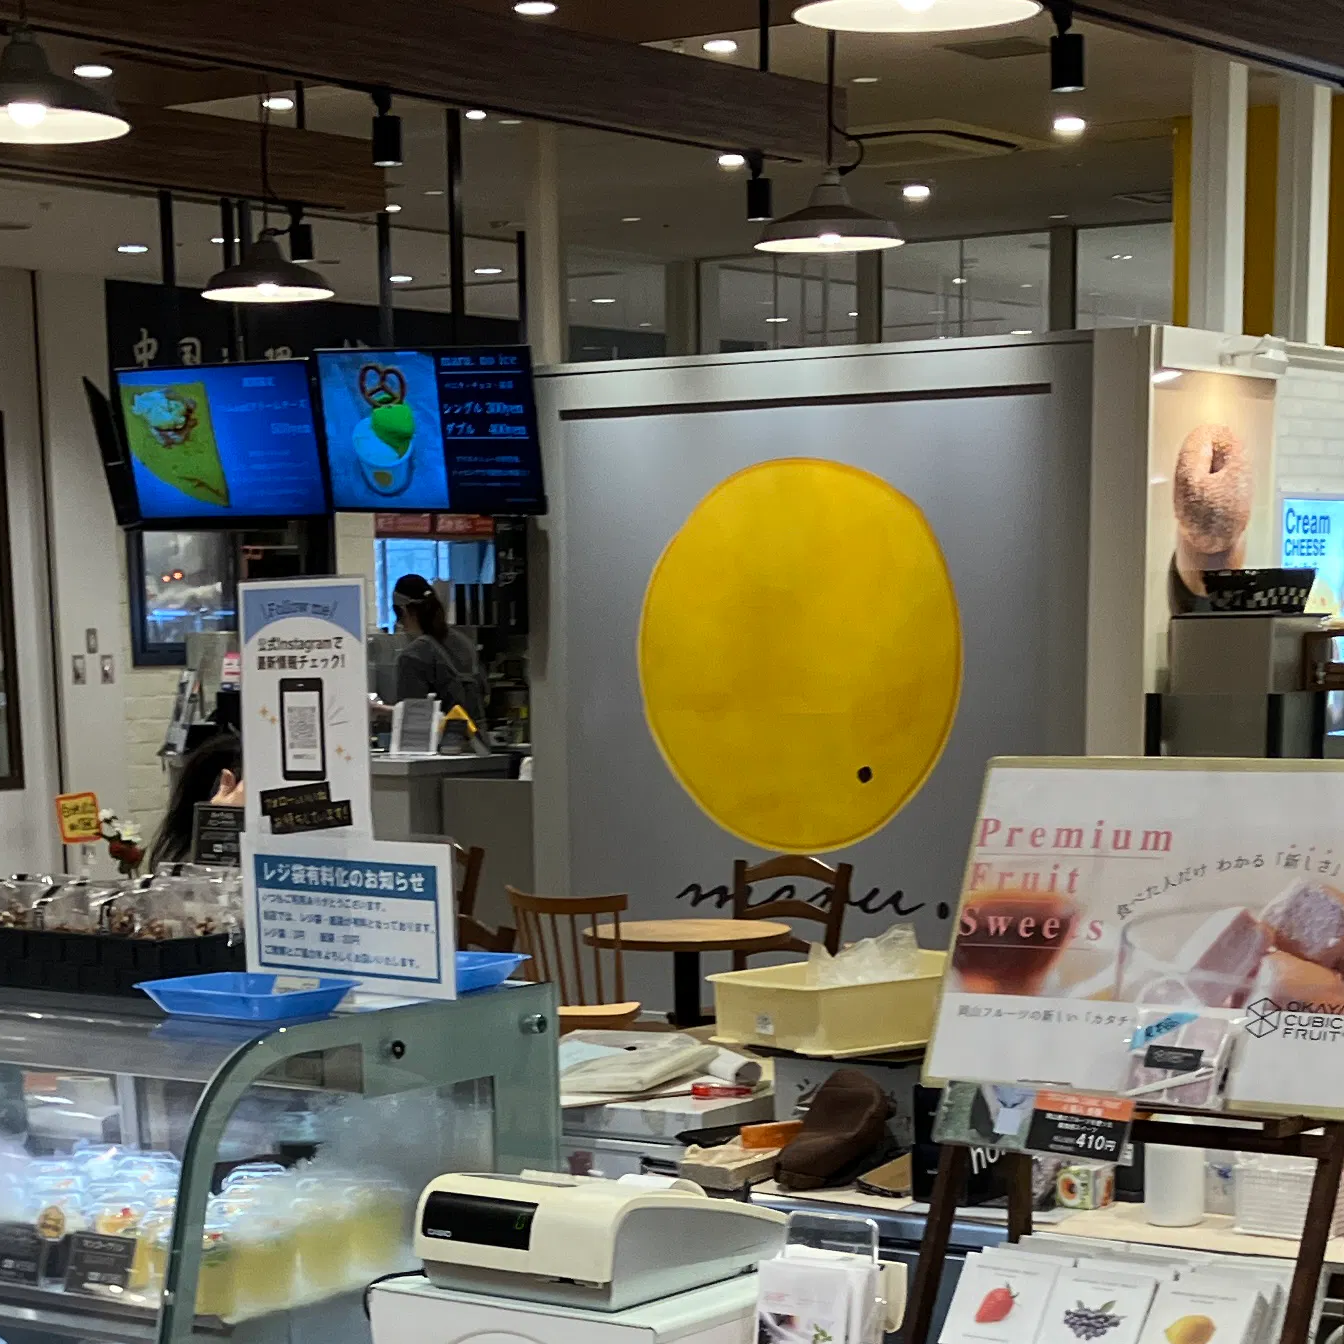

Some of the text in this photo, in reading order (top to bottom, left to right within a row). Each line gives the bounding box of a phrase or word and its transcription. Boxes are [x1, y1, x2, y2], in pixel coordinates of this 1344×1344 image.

[1284, 507, 1331, 535] Cream
[1284, 538, 1326, 557] CHEESE
[975, 817, 1174, 852] Premium
[262, 862, 425, 893] レジ袋有料化のお知らせ
[968, 862, 1081, 894] Fruit
[958, 906, 1104, 941] Sweets
[1284, 1014, 1344, 1030] CUBIC
[1076, 1132, 1117, 1152] 410円
